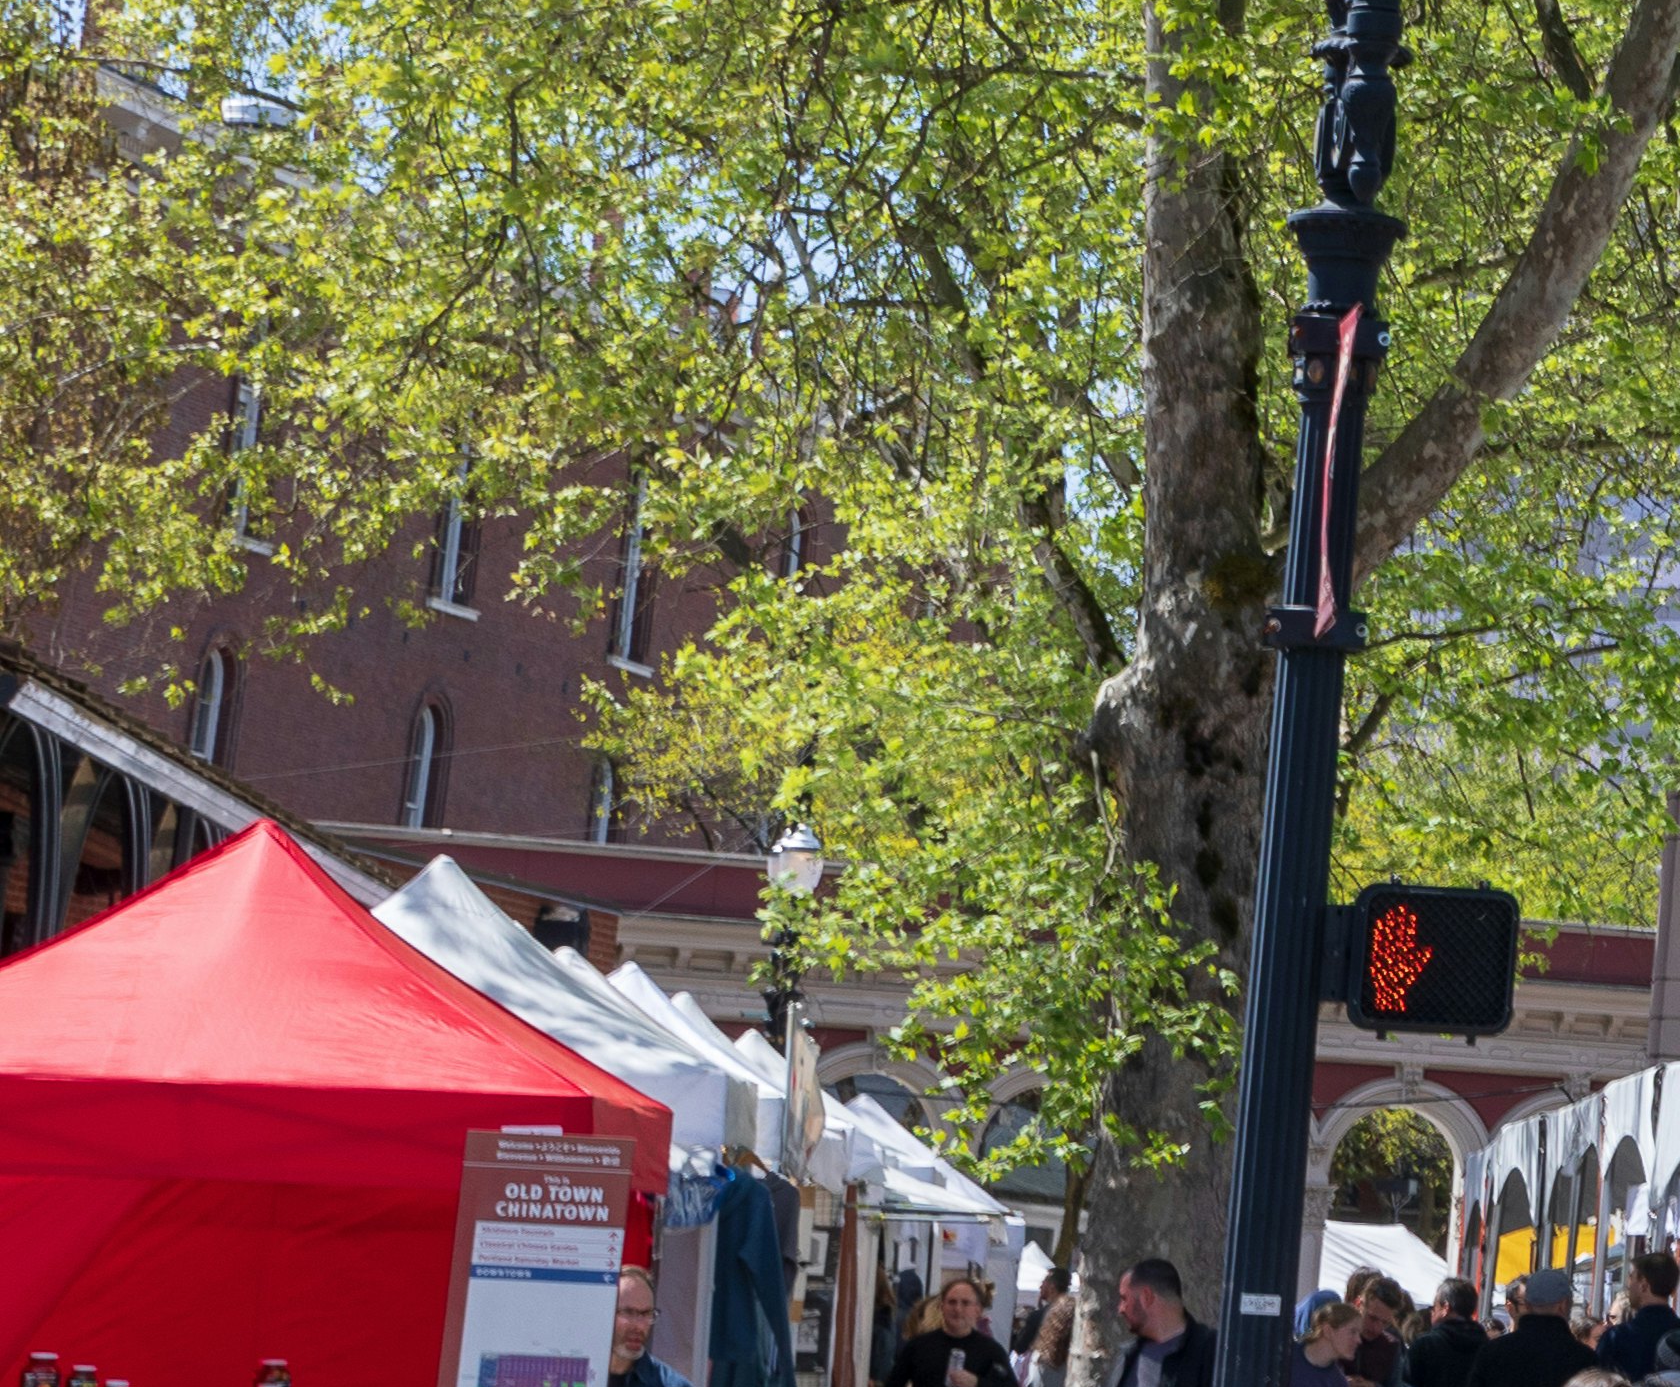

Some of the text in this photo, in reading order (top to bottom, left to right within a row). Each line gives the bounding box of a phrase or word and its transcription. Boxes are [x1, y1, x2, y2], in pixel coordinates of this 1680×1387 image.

[505, 1182, 604, 1203] OLD TOWN
[495, 1201, 609, 1222] CHINATOWN
